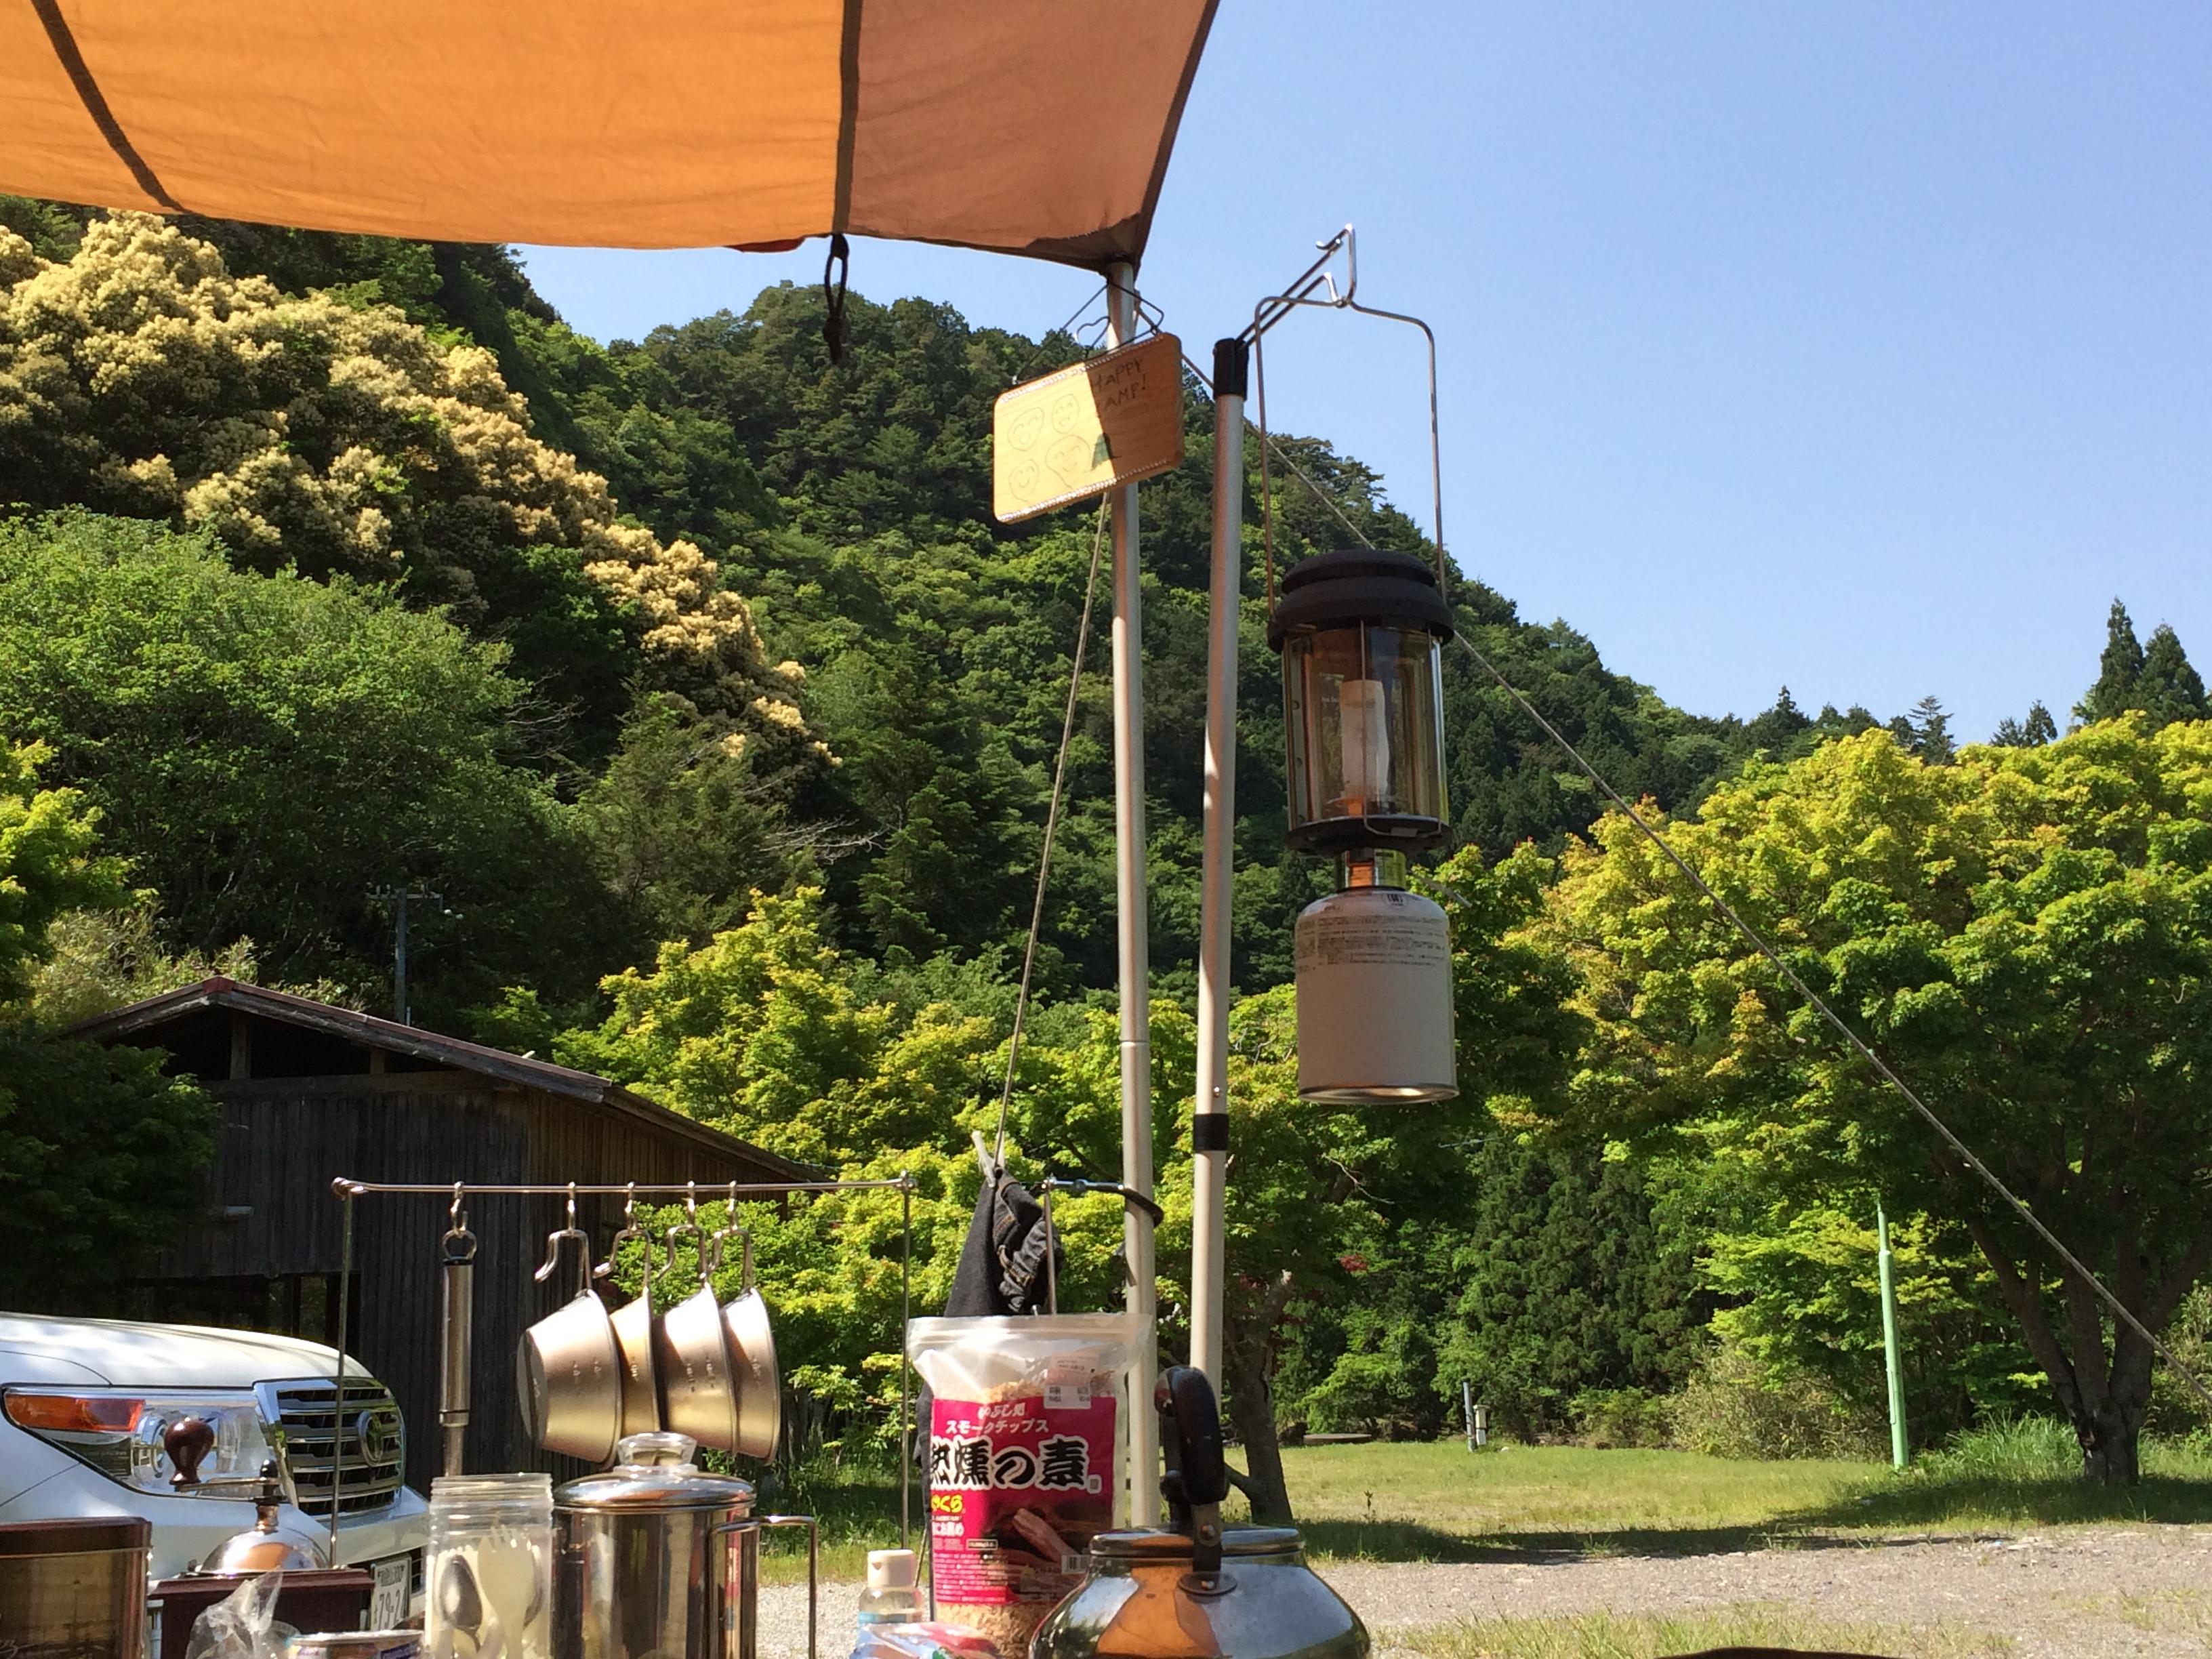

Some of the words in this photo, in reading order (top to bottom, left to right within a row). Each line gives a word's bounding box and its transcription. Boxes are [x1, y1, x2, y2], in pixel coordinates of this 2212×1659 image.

[945, 1418, 1049, 1435] スモークチップス
